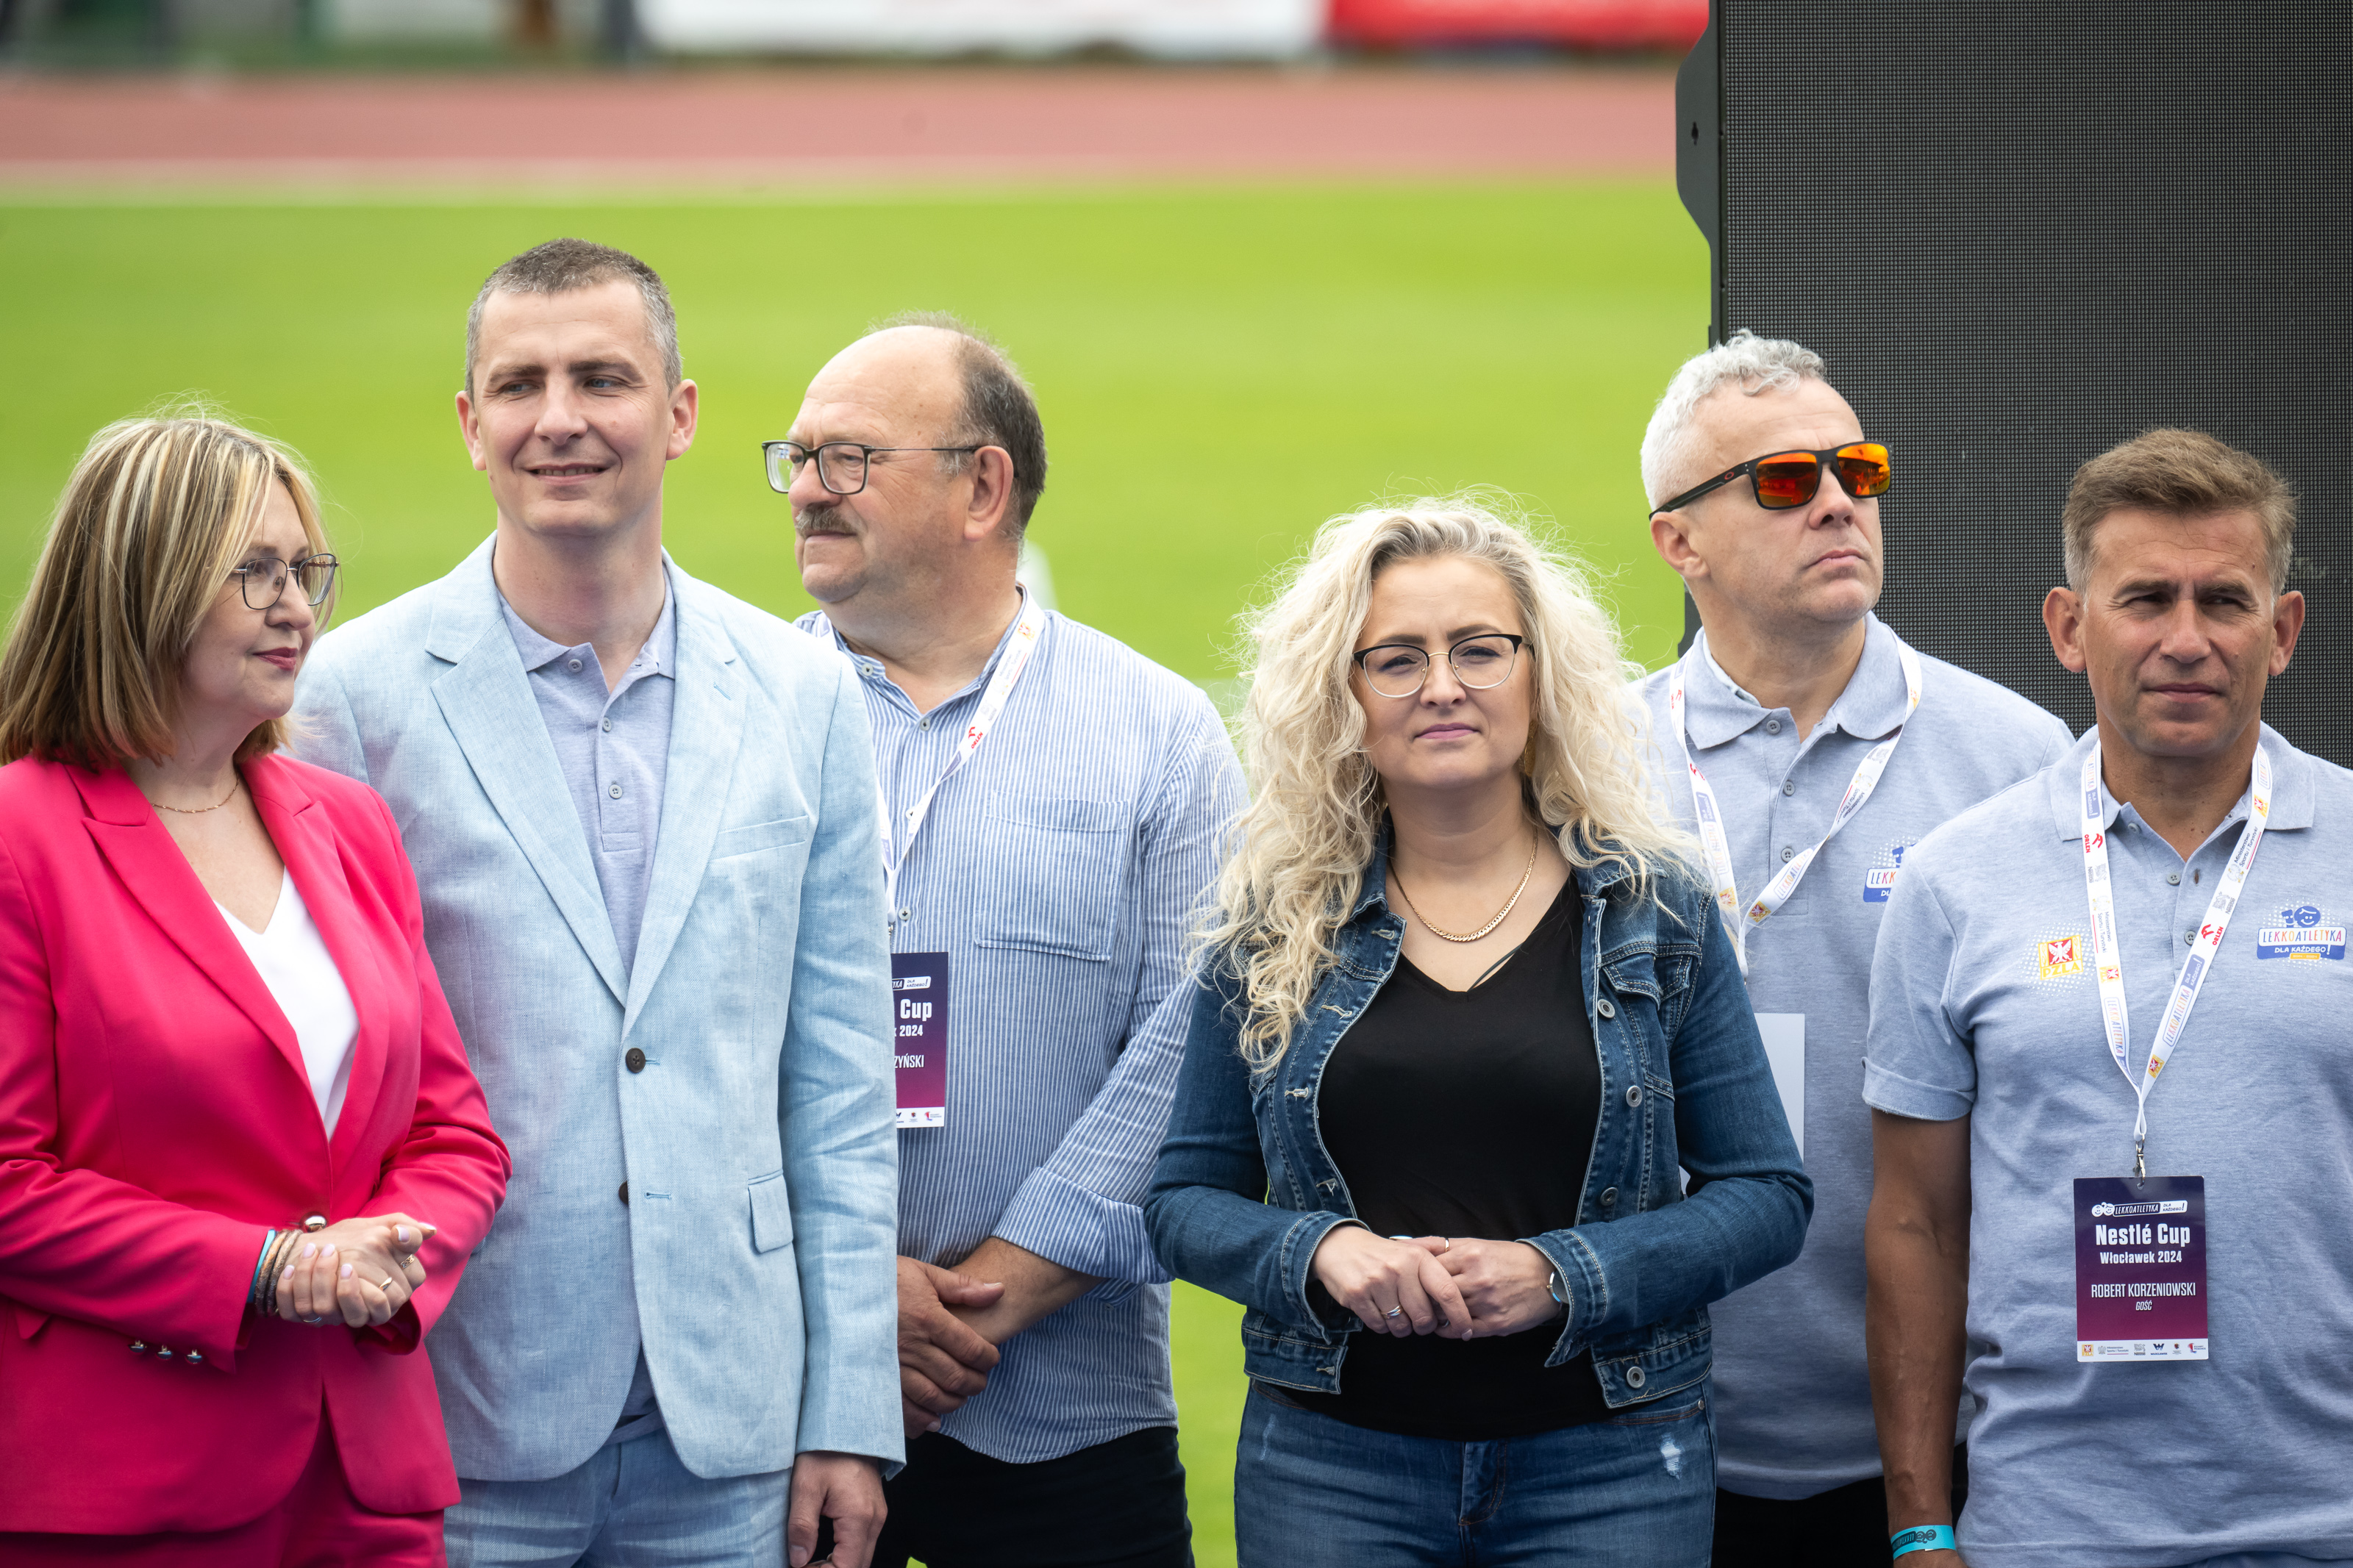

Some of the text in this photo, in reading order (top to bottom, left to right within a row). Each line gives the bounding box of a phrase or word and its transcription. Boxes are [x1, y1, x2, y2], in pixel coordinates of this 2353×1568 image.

[971, 731, 983, 749] ORLEN
[1871, 871, 1896, 884] LEKK
[2212, 926, 2224, 945] ORLEN
[2263, 930, 2341, 942] LEKKOATLETYKA
[2043, 962, 2080, 978] PZLA
[900, 998, 932, 1022] Cup
[2165, 989, 2190, 1042] LEKKOATLETYKA
[899, 1024, 924, 1037] 2024
[2107, 1000, 2124, 1053] LEKKOATLETYKA
[894, 1053, 924, 1068] ZYŃSKI
[2115, 1204, 2159, 1214] LEKKOATLETYKA
[2096, 1223, 2190, 1247] Nestlé Cup
[2100, 1250, 2182, 1264] Włocławek 2024
[2091, 1282, 2196, 1298] ROBERT KORZENIOWSKI
[2135, 1300, 2152, 1311] GOŚĆ
